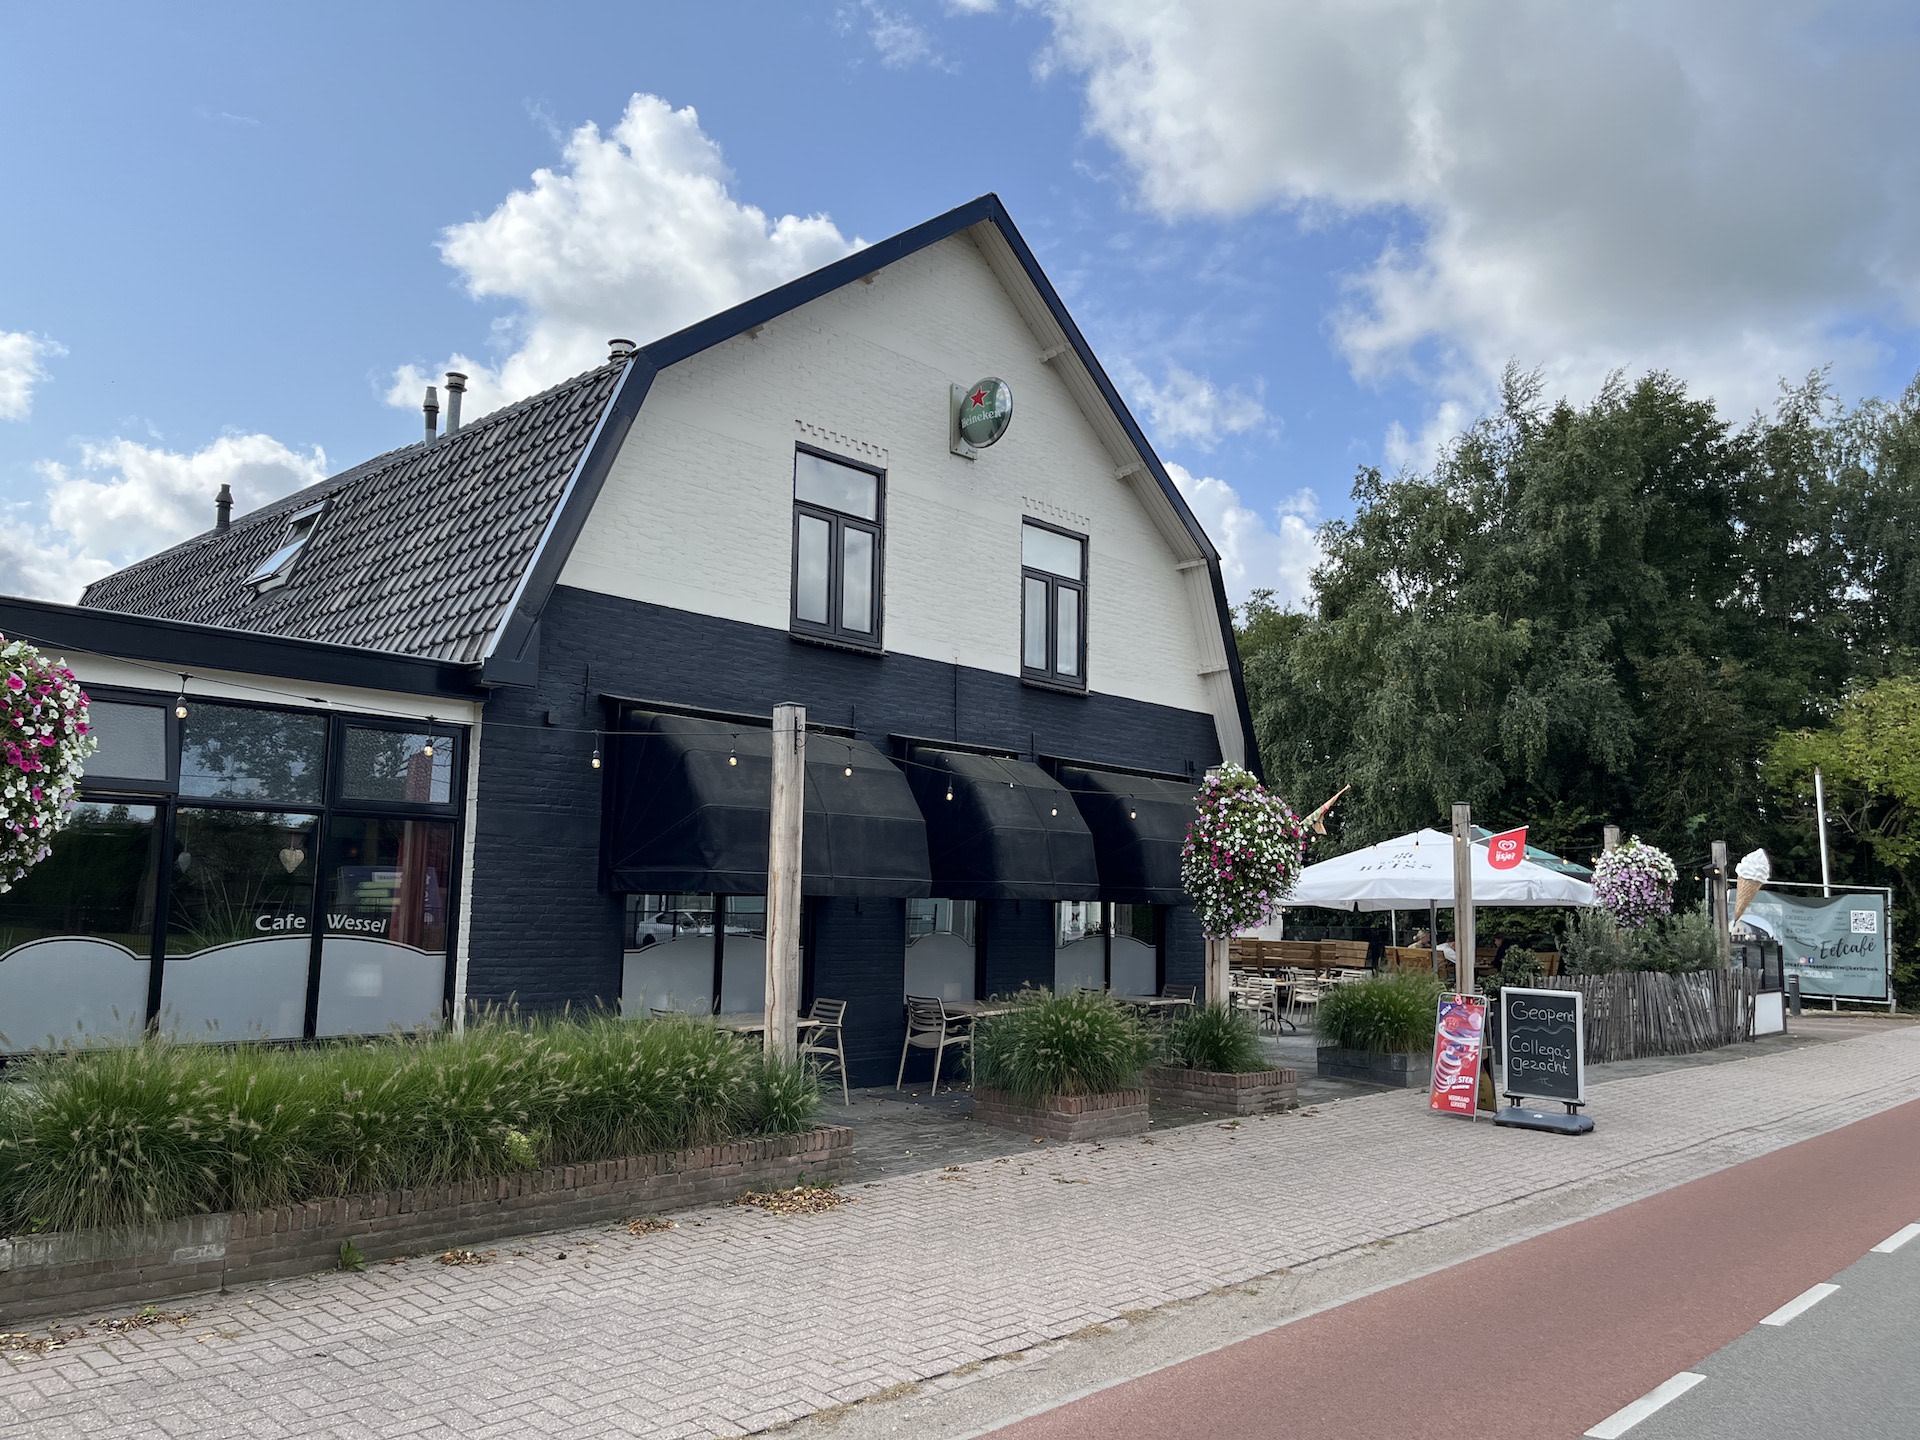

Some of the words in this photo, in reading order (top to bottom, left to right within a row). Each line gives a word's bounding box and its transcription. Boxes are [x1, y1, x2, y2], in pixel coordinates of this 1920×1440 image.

[961, 409, 1001, 428] Heineken
[1495, 851, 1516, 862] ijsje?
[255, 913, 307, 931] Cafe
[326, 913, 387, 933] Wessel
[1820, 935, 1876, 959] Eetcafé
[1510, 1000, 1576, 1027] Geopend
[1511, 1056, 1570, 1077] gezocht
